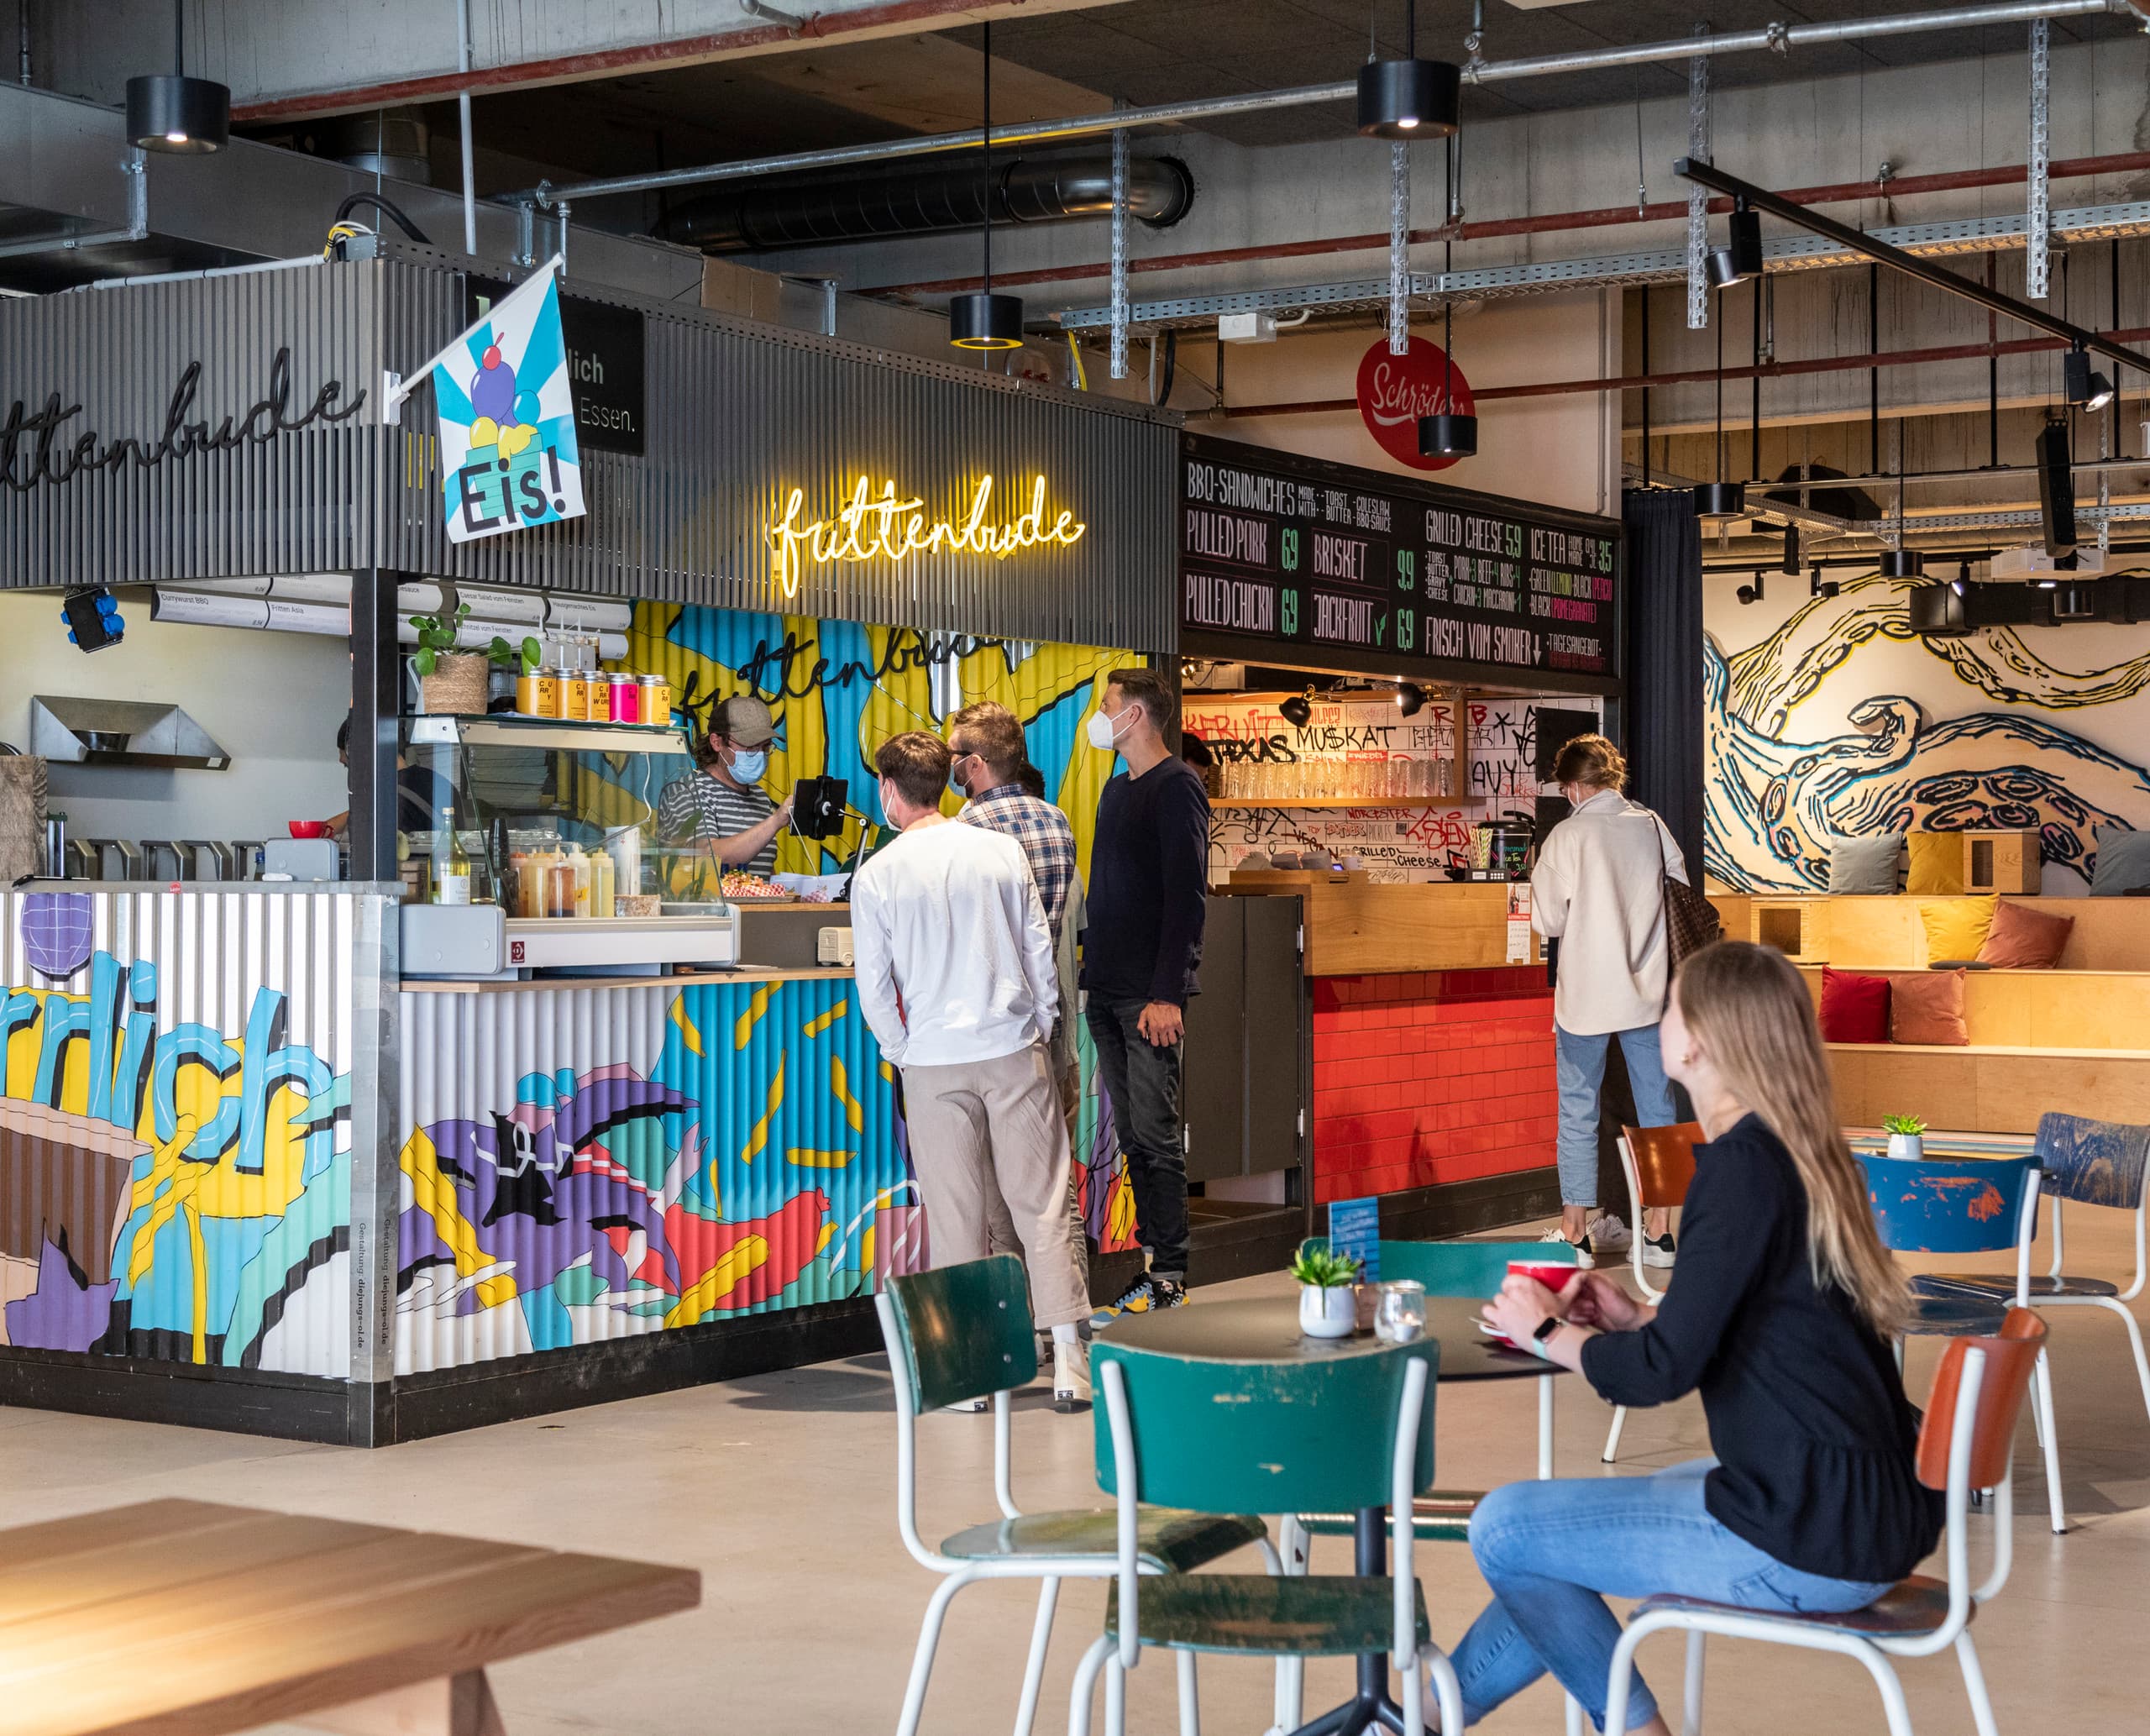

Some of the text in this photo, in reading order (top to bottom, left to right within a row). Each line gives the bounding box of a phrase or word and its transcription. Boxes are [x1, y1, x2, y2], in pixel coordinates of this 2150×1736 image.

[580, 396, 636, 433] Essen.
[459, 445, 566, 534] Eis!
[1188, 462, 1296, 516] BBQ-SANDWICHES
[773, 475, 1086, 599] frittenbude
[1187, 509, 1267, 564] PULLED PORK
[1426, 510, 1462, 547] GRILLED
[1466, 517, 1503, 553] CHEESE
[1531, 528, 1546, 561] ICE
[1547, 532, 1565, 564] TEA
[1314, 533, 1369, 581] BRISKET
[160, 593, 209, 606] Currywurst BBQ
[1185, 574, 1230, 626] PULLED
[1314, 594, 1374, 644] JACKFRUIT
[1426, 616, 1464, 658] FRISCH
[1467, 622, 1491, 661] VOM
[1493, 627, 1532, 665] SMOKER
